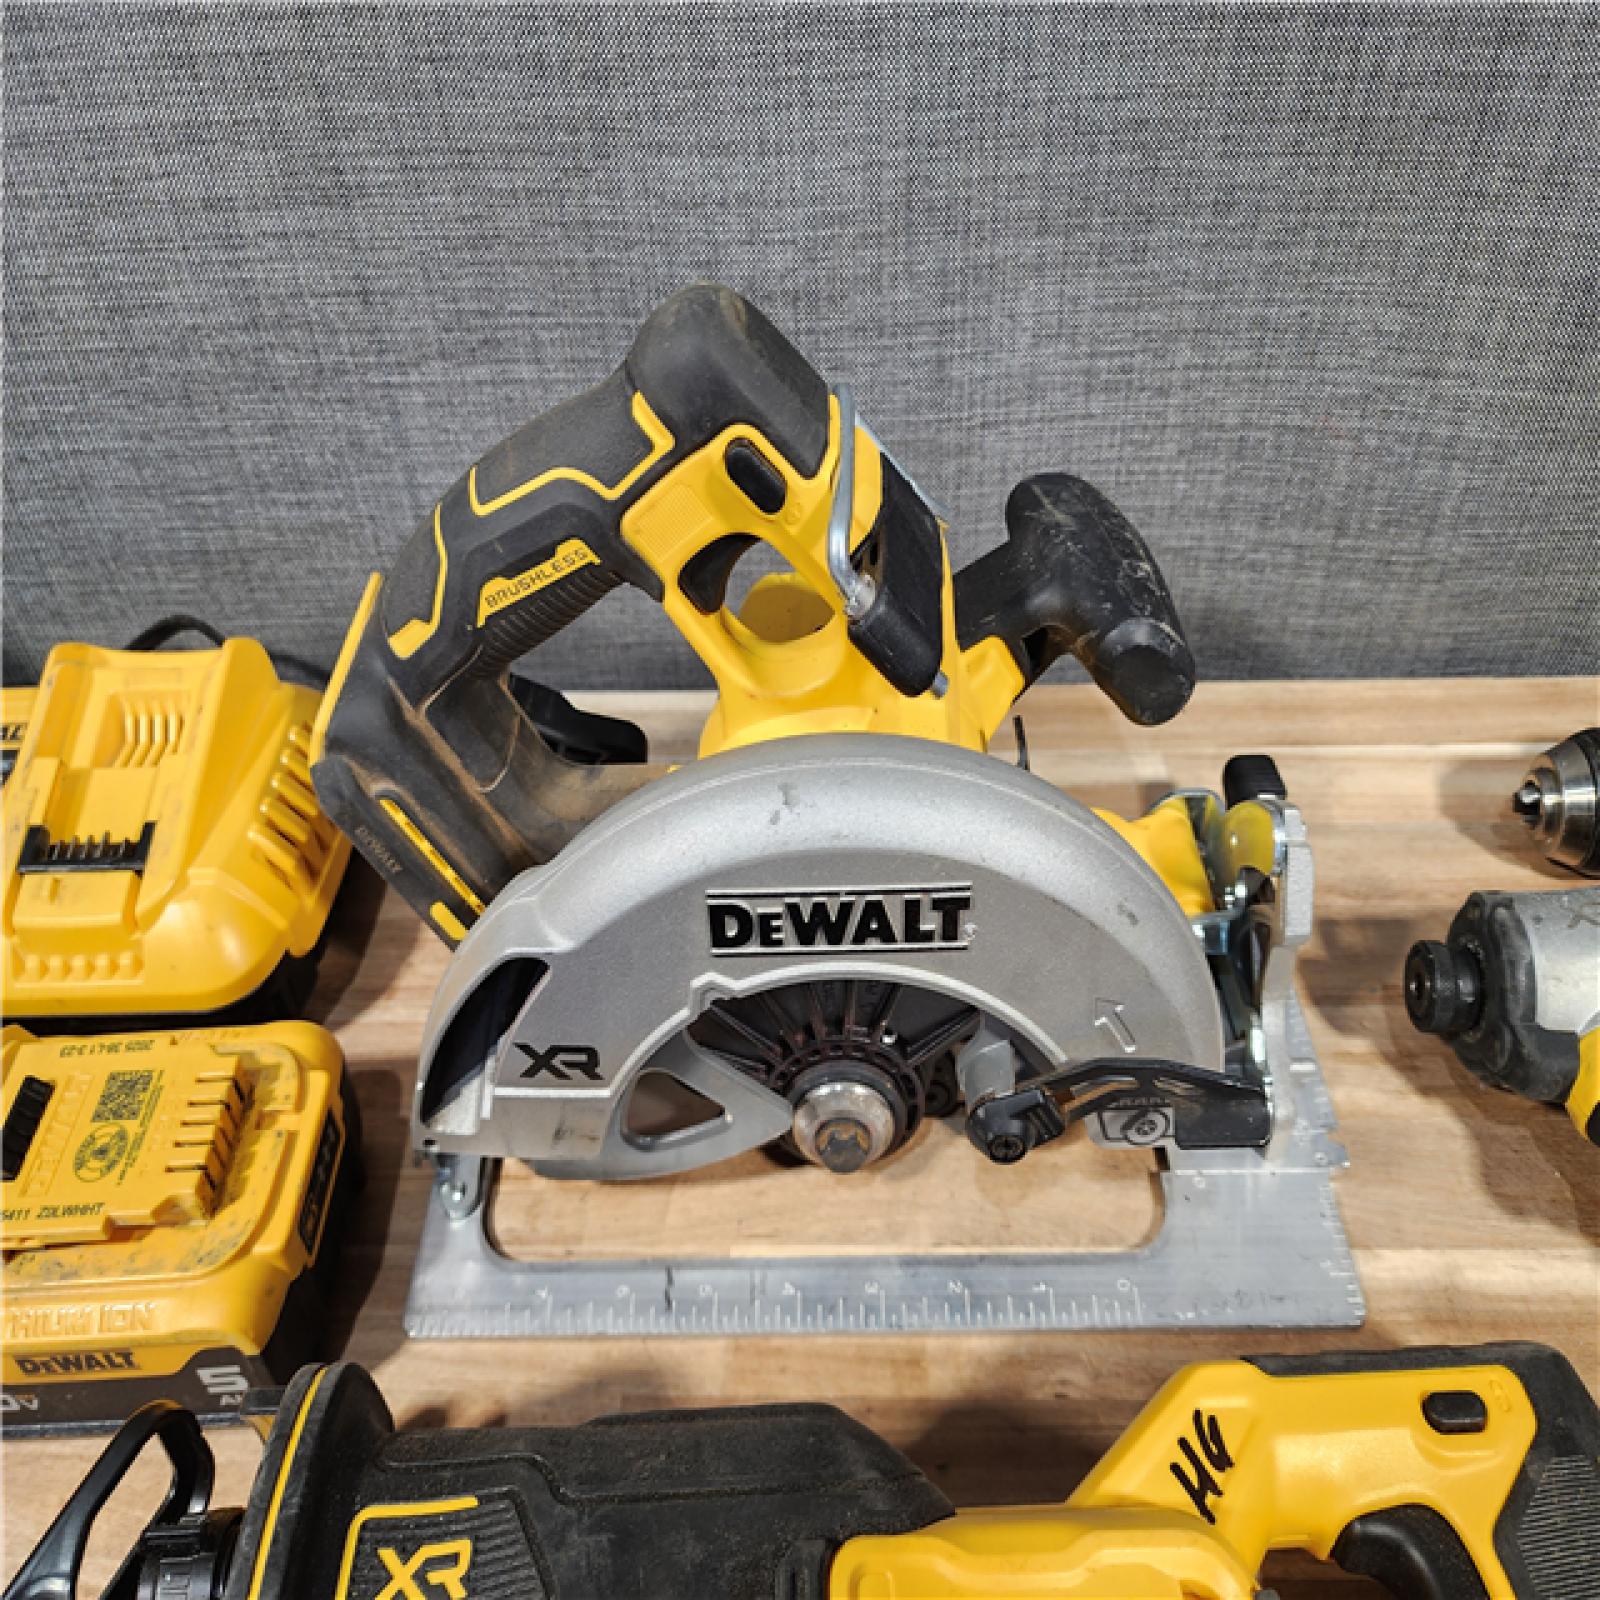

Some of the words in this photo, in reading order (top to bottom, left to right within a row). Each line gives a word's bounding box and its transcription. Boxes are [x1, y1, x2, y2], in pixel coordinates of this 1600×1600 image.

[485, 548, 589, 608] BRUSHLESS
[513, 1041, 604, 1081] XR
[196, 1365, 248, 1393] 5
[374, 1539, 473, 1600] XR
